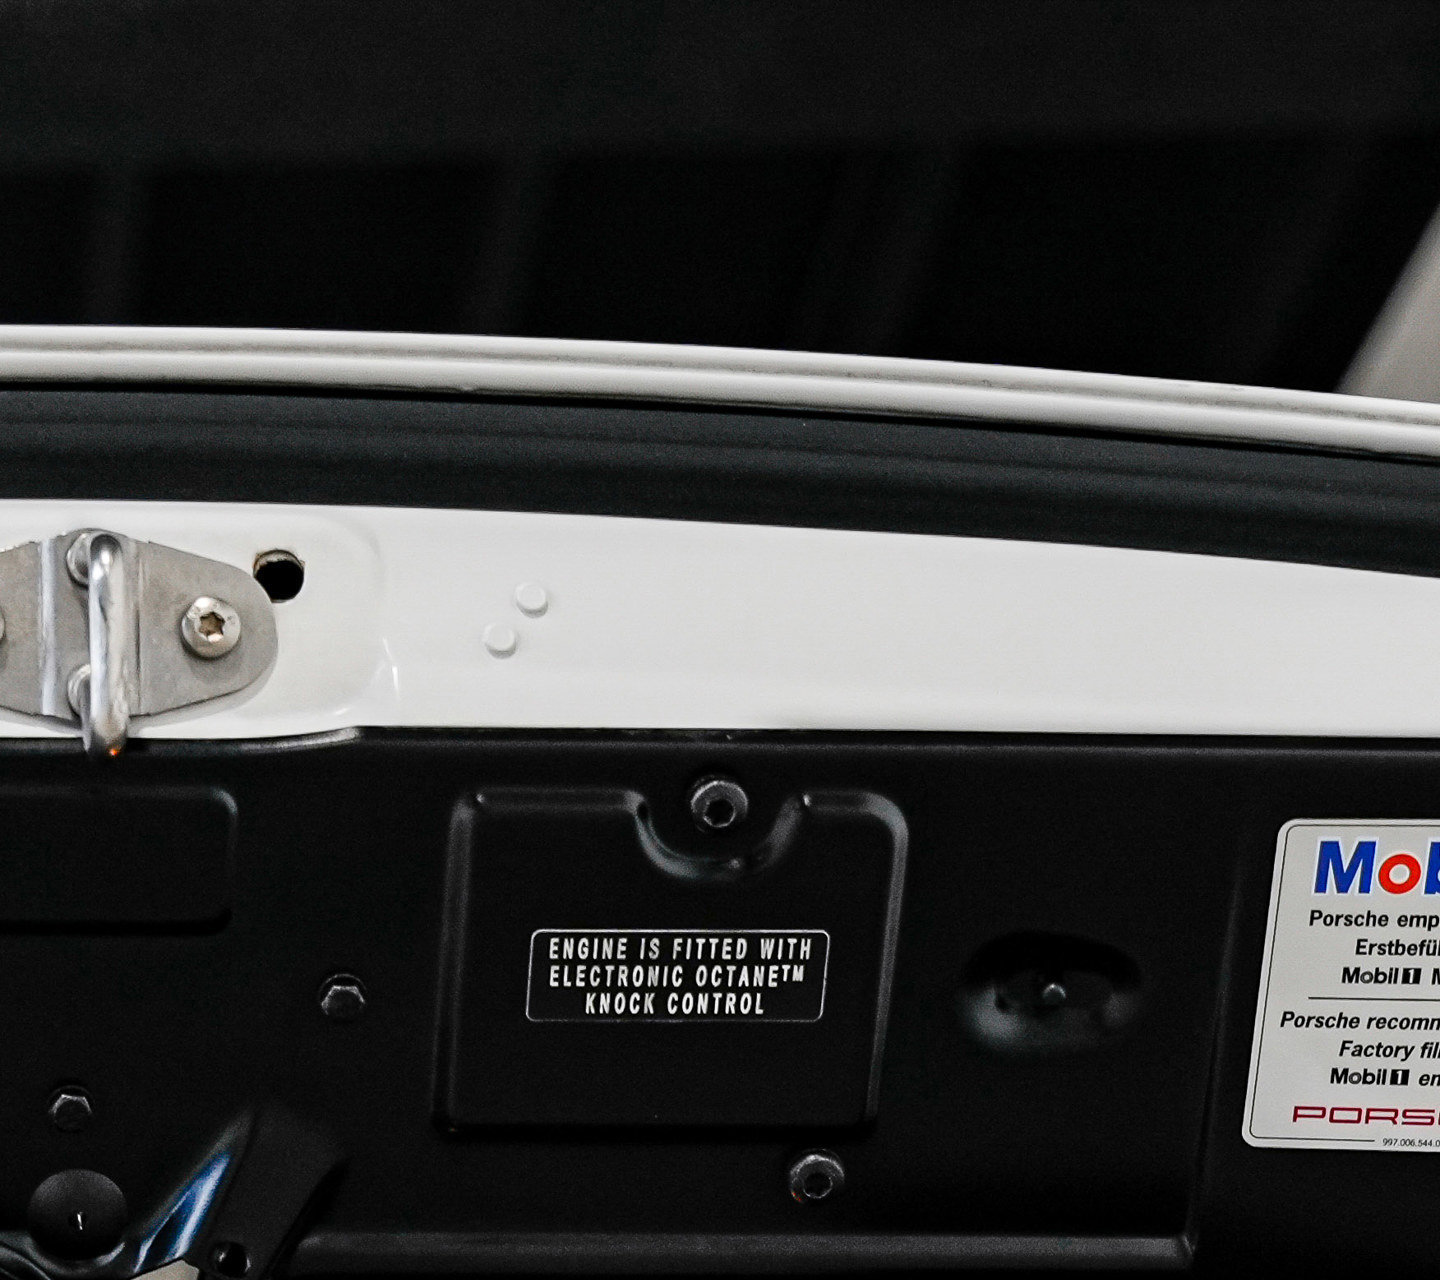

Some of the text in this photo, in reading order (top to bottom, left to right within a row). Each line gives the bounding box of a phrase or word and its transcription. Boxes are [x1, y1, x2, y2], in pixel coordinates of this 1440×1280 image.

[1309, 910, 1389, 928] Porsche
[549, 937, 812, 960] ENGINE IS FITTED WITH
[549, 964, 683, 987] ELECTRONIC
[585, 992, 764, 1015] KNOCK CONTROL
[1280, 1011, 1361, 1029] Porsche
[1338, 1040, 1415, 1061] Factory
